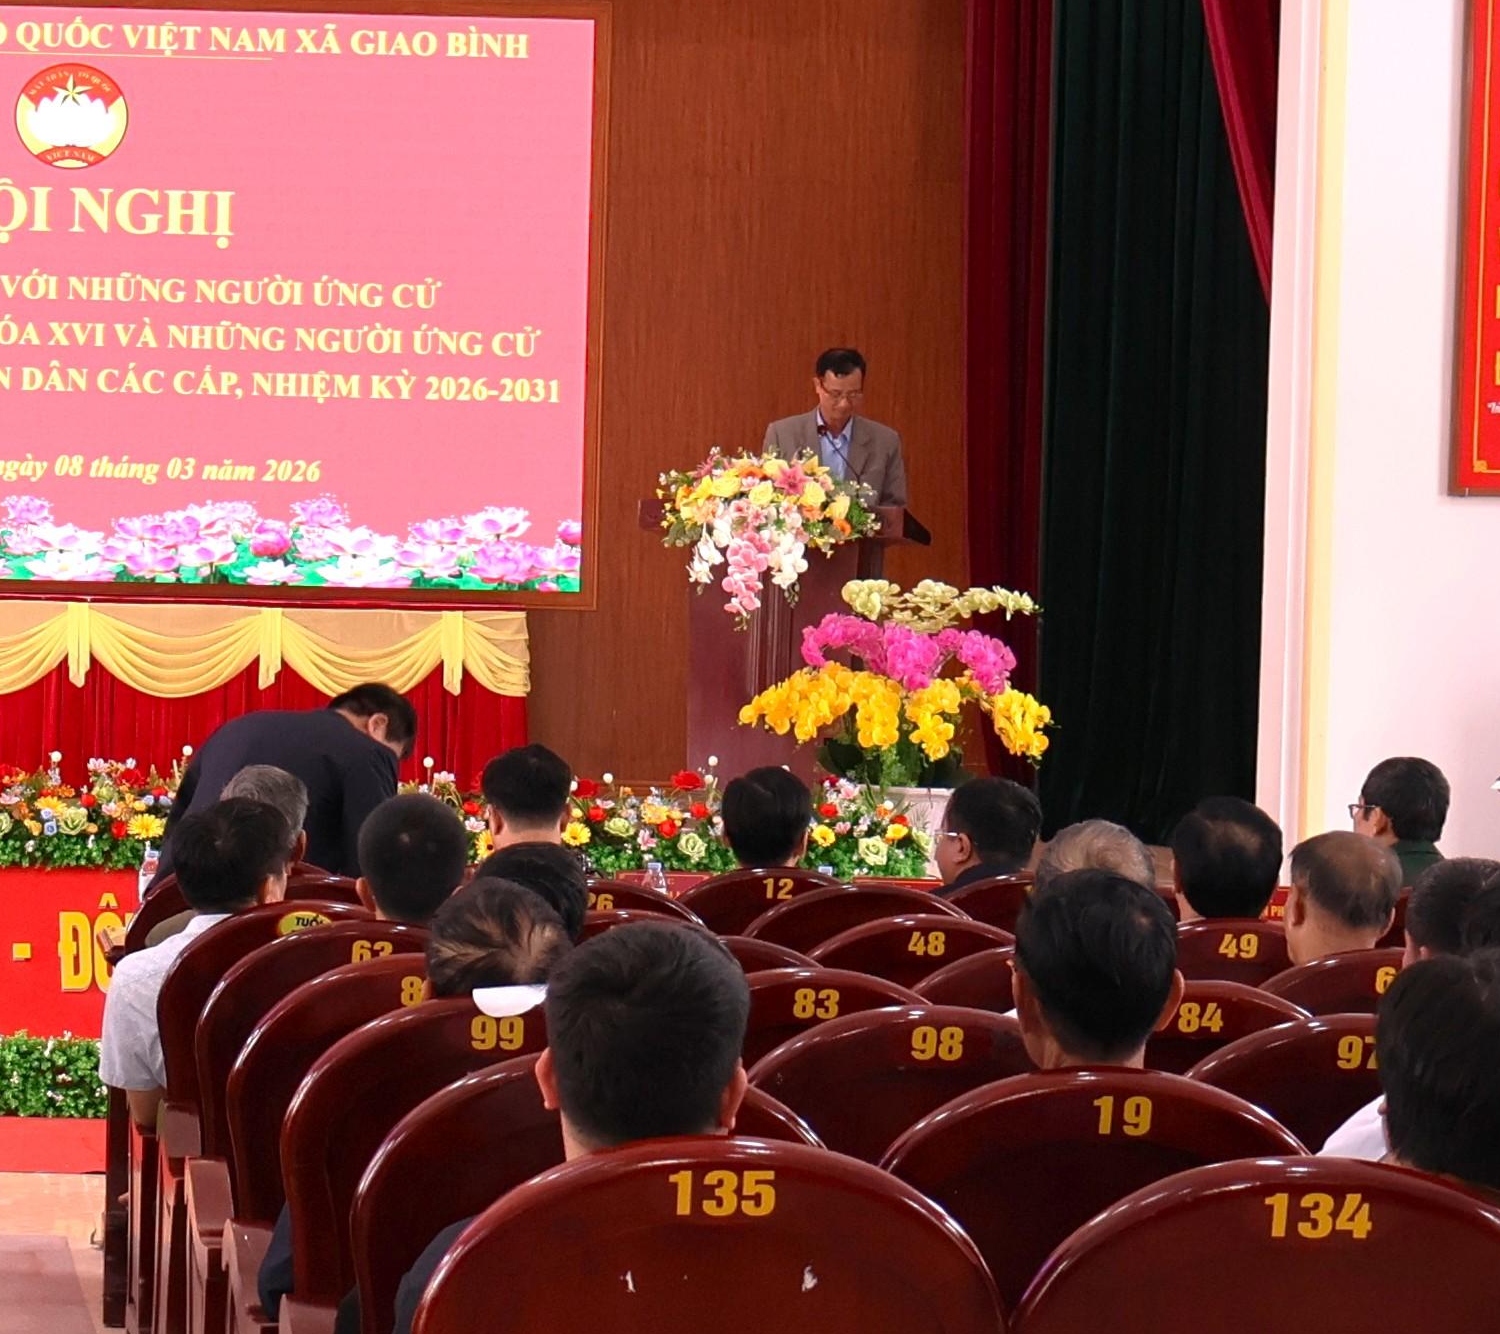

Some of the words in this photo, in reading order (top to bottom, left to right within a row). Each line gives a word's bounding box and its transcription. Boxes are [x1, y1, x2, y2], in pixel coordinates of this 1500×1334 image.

[16, 16, 113, 51] QUỐC
[122, 22, 202, 56] VIỆT
[210, 27, 285, 52] NAM
[295, 24, 341, 54] XÃ
[351, 30, 437, 56] GIAO
[447, 26, 528, 58] BÌNH
[70, 188, 234, 248] NGHỊ
[0, 269, 57, 299] VỚI
[68, 272, 186, 302] NHỮNG
[195, 274, 302, 305] NGƯỜI
[314, 275, 383, 307] ỨNG
[392, 278, 442, 308] CỬ
[48, 322, 104, 346] XVI
[114, 317, 157, 347] VÀ
[168, 321, 285, 351] NHỮNG
[296, 323, 402, 353] NGƯỜI
[413, 324, 483, 355] ỨNG
[492, 326, 541, 357] CỬ
[22, 360, 88, 391] DÂN
[97, 363, 164, 393] CÁC
[173, 365, 243, 399] CẤP,
[252, 371, 360, 403] NHIỆM
[370, 369, 416, 399] KỲ
[426, 376, 559, 402] 2026-2031
[55, 455, 84, 476] 08
[90, 456, 160, 484] tháng
[167, 458, 196, 479] 03
[202, 459, 255, 481] năm
[262, 459, 320, 482] 2026
[763, 878, 793, 899] 12
[908, 932, 945, 955] 48
[1219, 934, 1258, 958] 49
[793, 988, 839, 1019] 83
[1178, 1001, 1224, 1033] 84
[470, 1015, 524, 1050] 99
[911, 1026, 963, 1060] 98
[1094, 1096, 1152, 1136] 19
[669, 1170, 775, 1216] 135
[1265, 1193, 1372, 1238] 134
